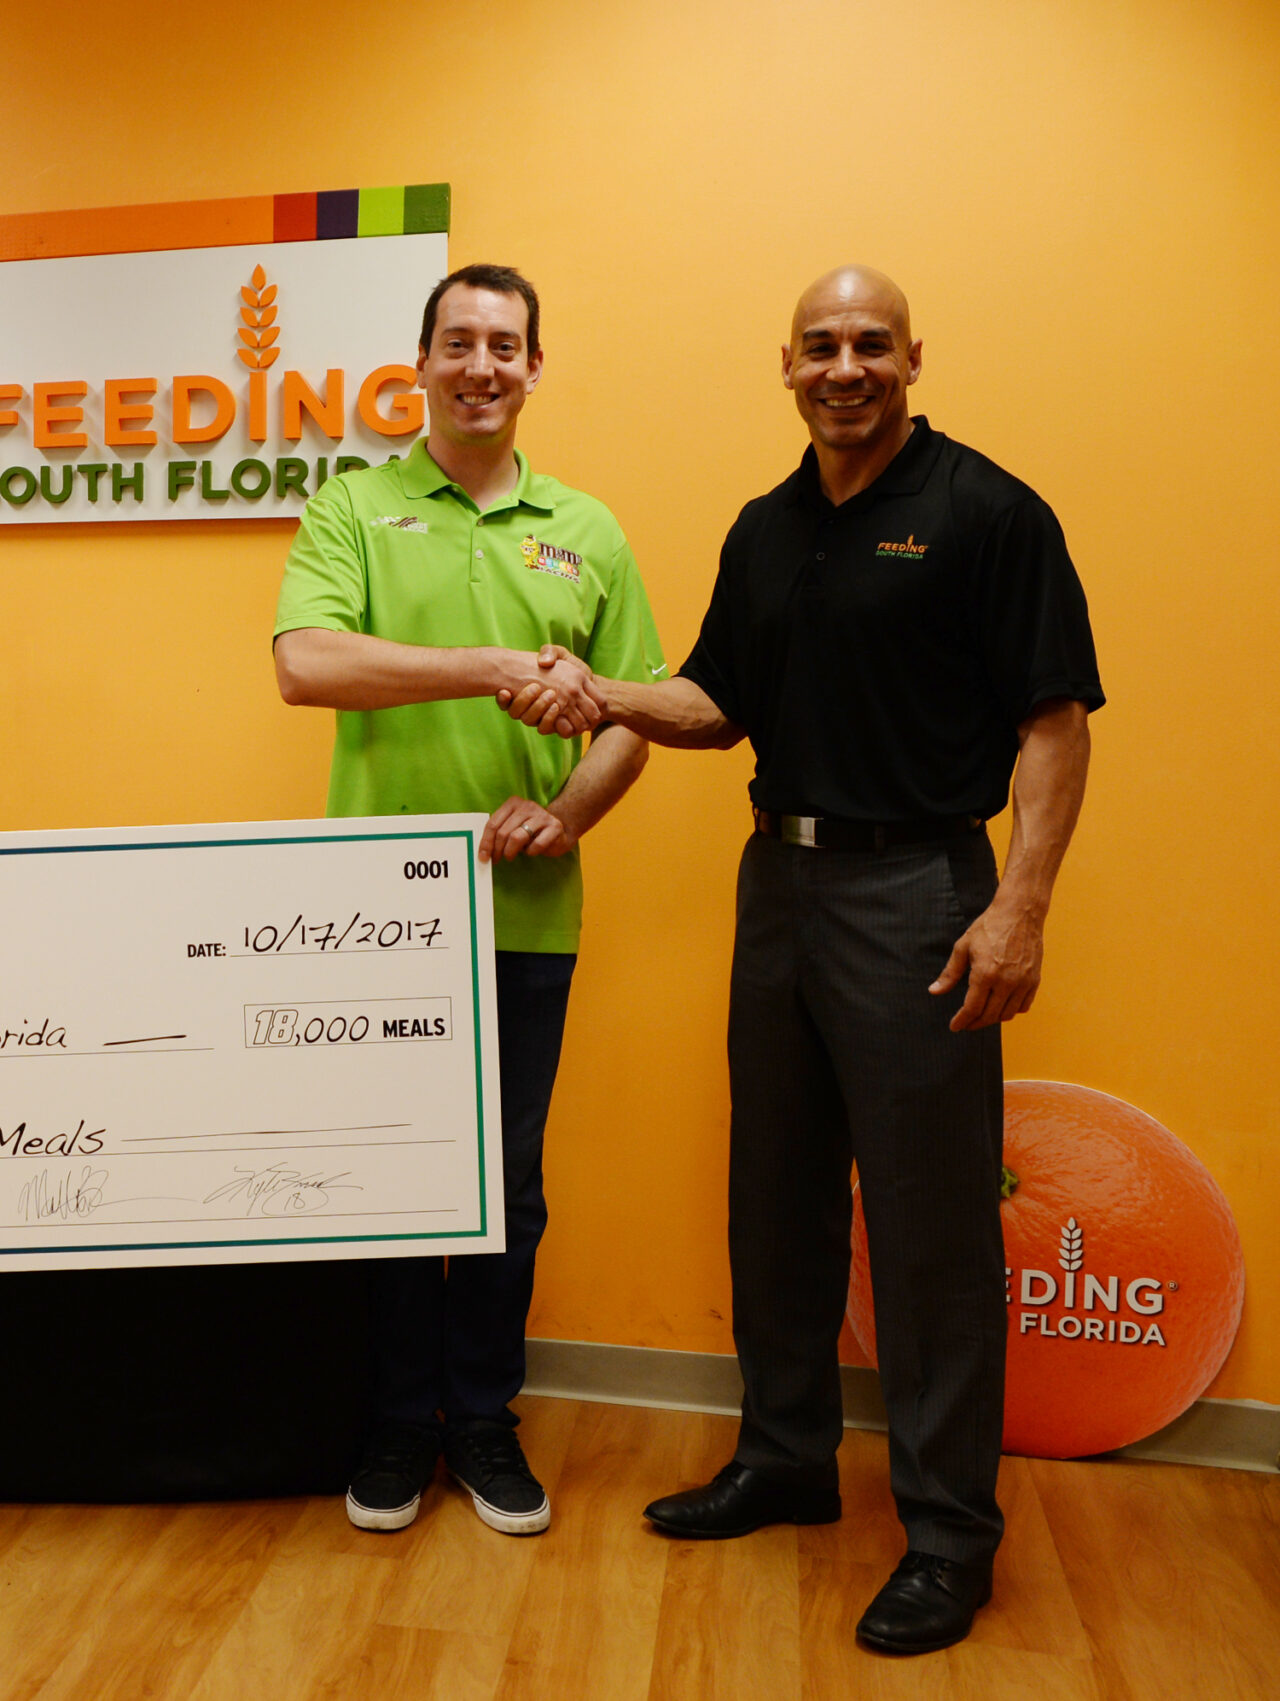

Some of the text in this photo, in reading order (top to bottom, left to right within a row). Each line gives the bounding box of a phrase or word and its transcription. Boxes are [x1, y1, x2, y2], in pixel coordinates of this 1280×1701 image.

[168, 455, 401, 500] FLORI
[878, 543, 926, 553] FEEDING
[404, 861, 449, 880] 0001
[245, 912, 442, 952] 10/17/2017
[187, 942, 226, 958] DATE:
[253, 1009, 445, 1046] 18,000 MEALS
[1020, 1313, 1165, 1346] FLORIDA
